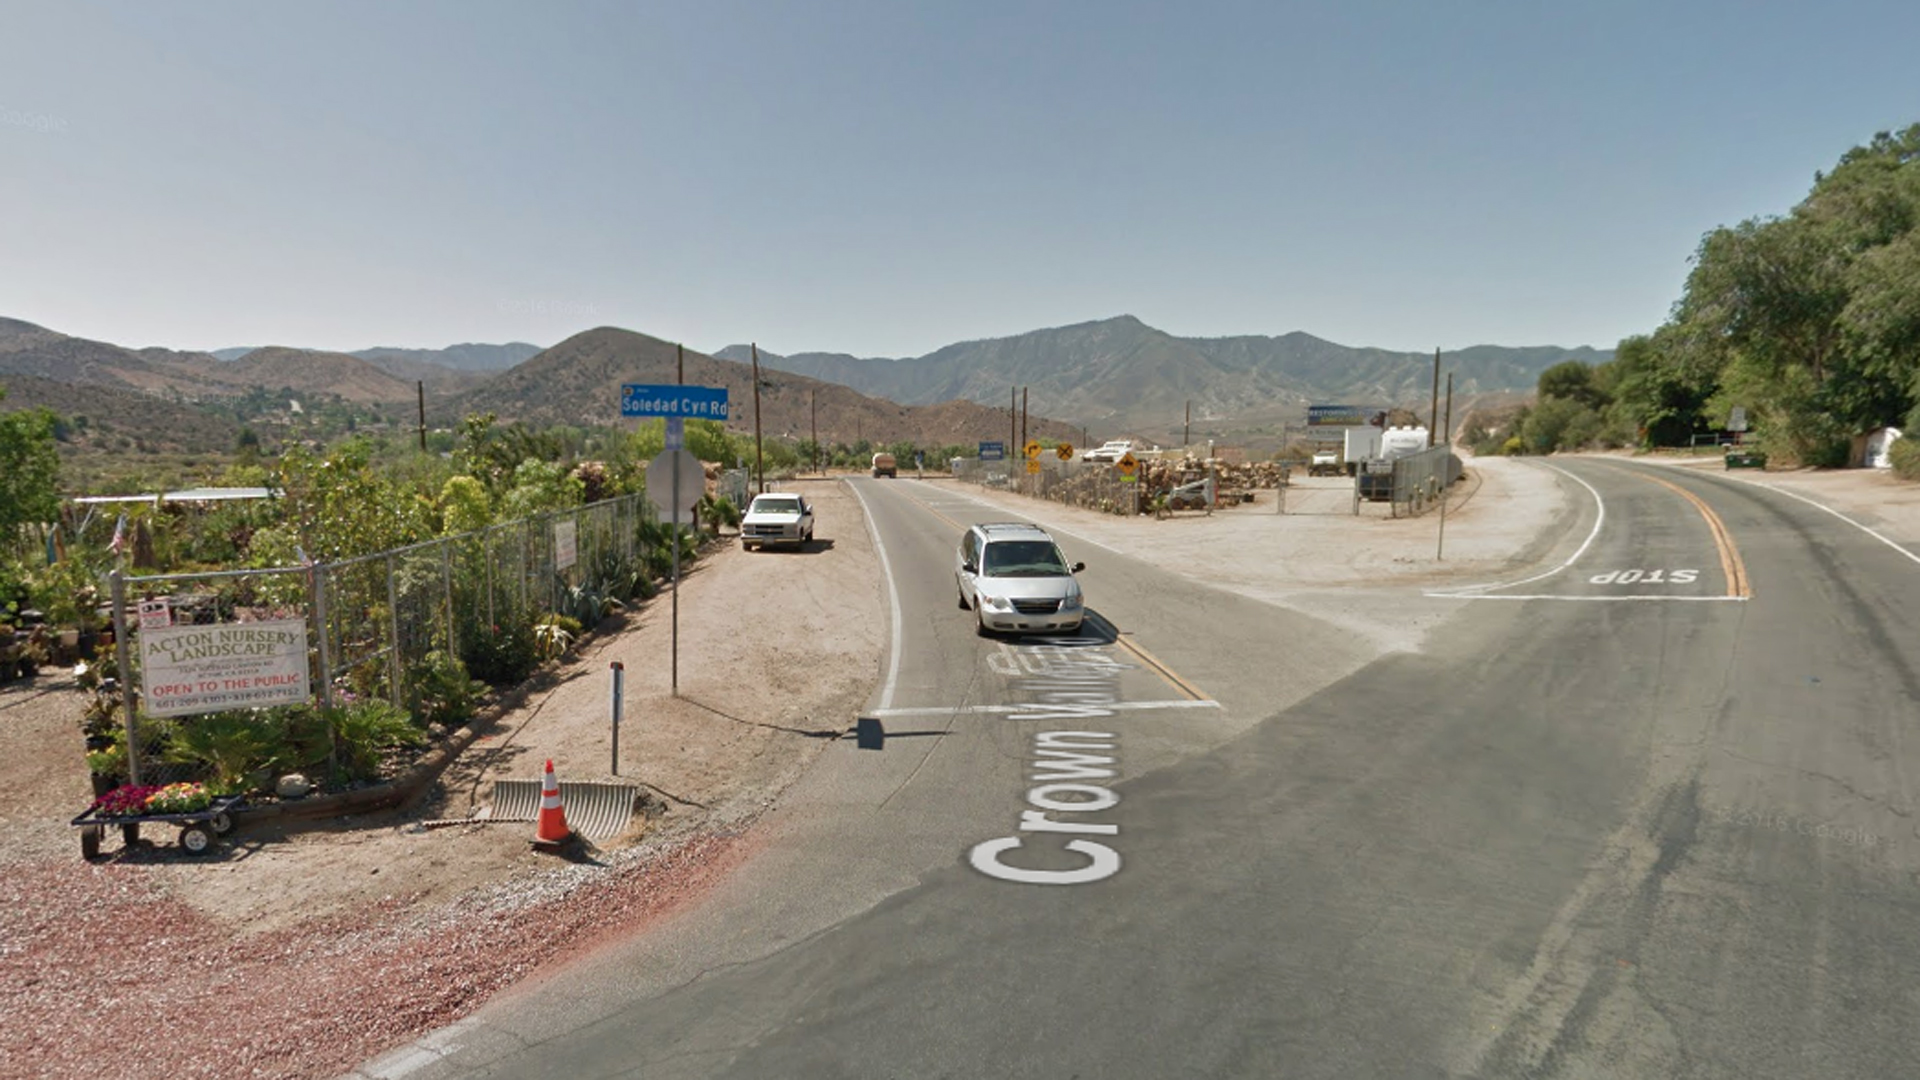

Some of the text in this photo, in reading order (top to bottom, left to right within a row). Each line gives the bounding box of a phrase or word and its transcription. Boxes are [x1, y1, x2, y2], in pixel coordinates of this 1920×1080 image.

[623, 397, 727, 415] Soledad Cyn Rd
[1589, 569, 1699, 584] STOP
[148, 629, 299, 655] ACTON NURSERY
[171, 642, 276, 663] LANDSCAPE
[153, 673, 300, 697] OPEN TO THE PUBLIC
